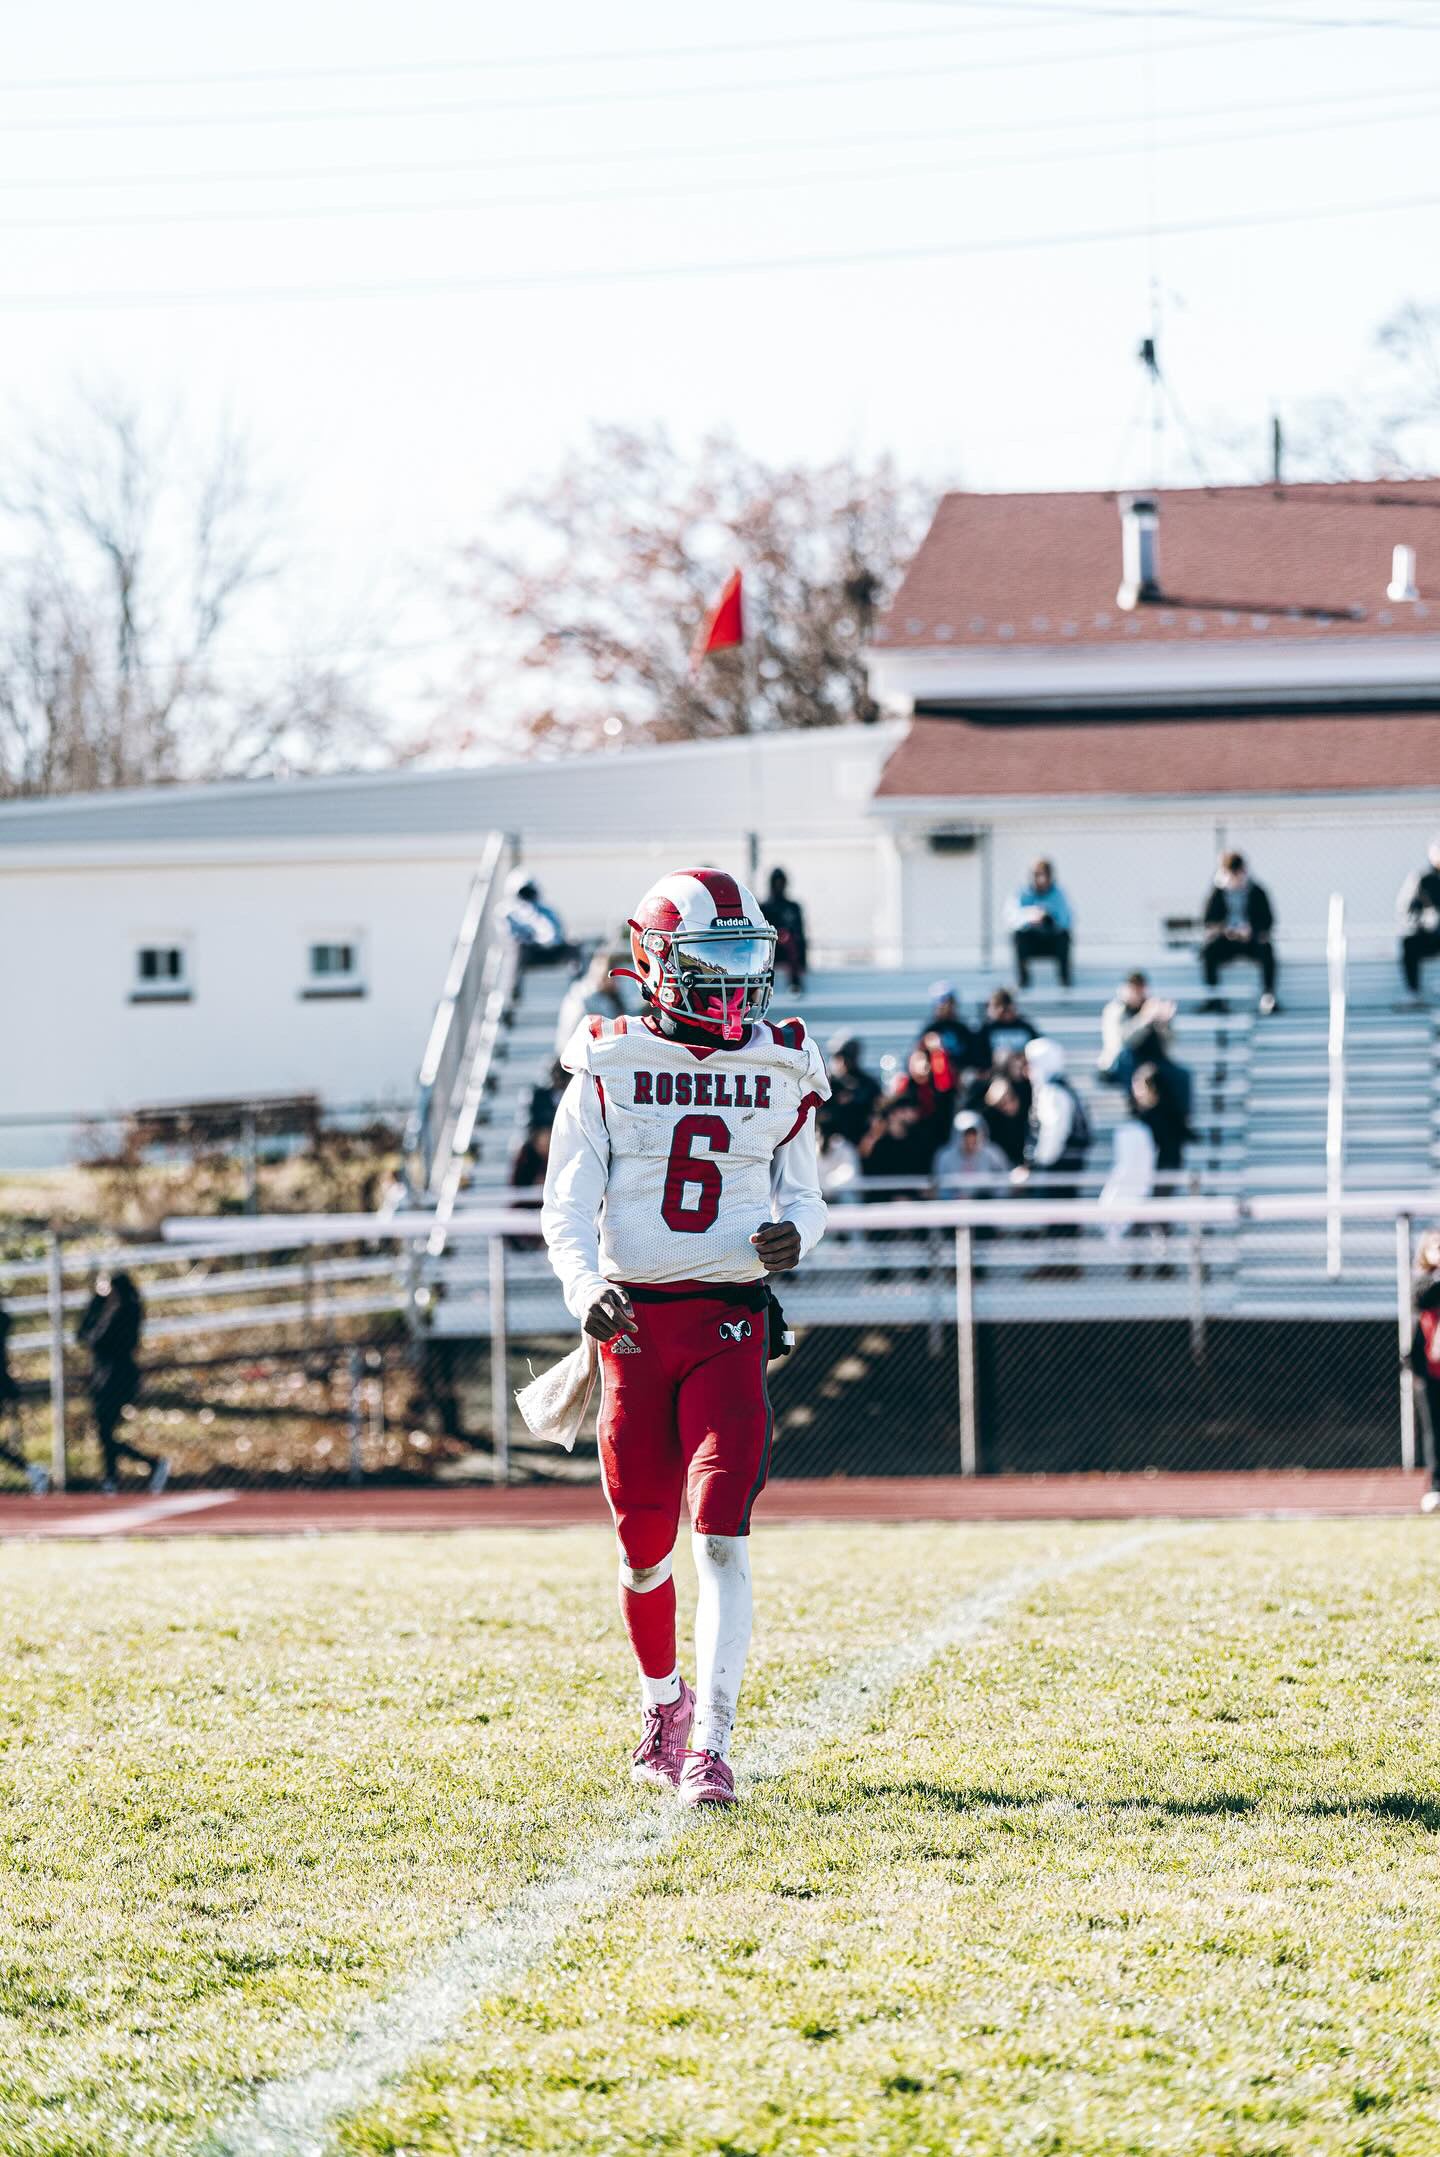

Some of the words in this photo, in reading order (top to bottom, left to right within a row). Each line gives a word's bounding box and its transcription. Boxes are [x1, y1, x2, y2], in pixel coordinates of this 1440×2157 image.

[716, 918, 749, 927] Riddell
[634, 1071, 771, 1108] ROSELLE
[661, 1114, 731, 1233] 6
[611, 1345, 641, 1354] adidas
